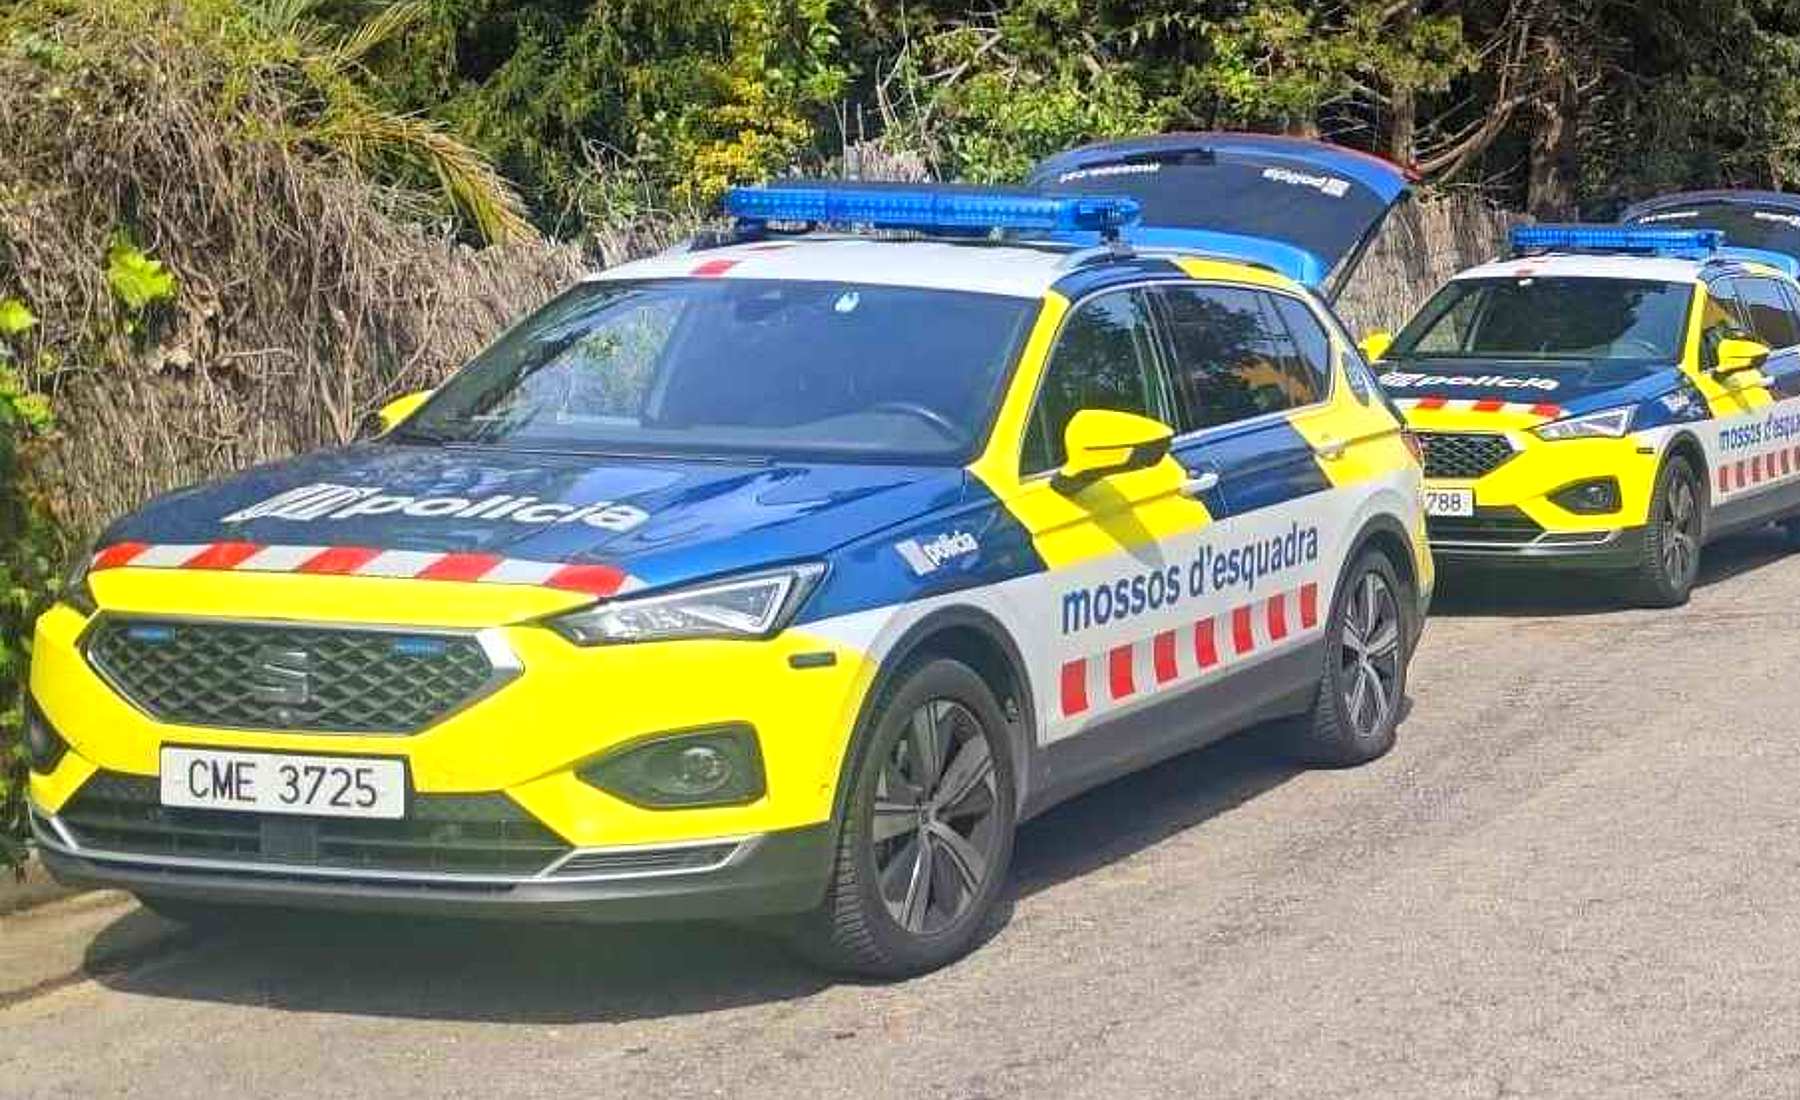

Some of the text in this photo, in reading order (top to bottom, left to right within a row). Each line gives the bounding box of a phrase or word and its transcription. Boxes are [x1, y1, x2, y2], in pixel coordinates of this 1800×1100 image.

[1419, 375, 1560, 391] policia
[338, 494, 650, 532] policia
[1426, 492, 1461, 512] 788
[923, 530, 979, 567] policia
[1062, 521, 1318, 635] mossos d'esquadra
[188, 758, 378, 808] CME 3725
